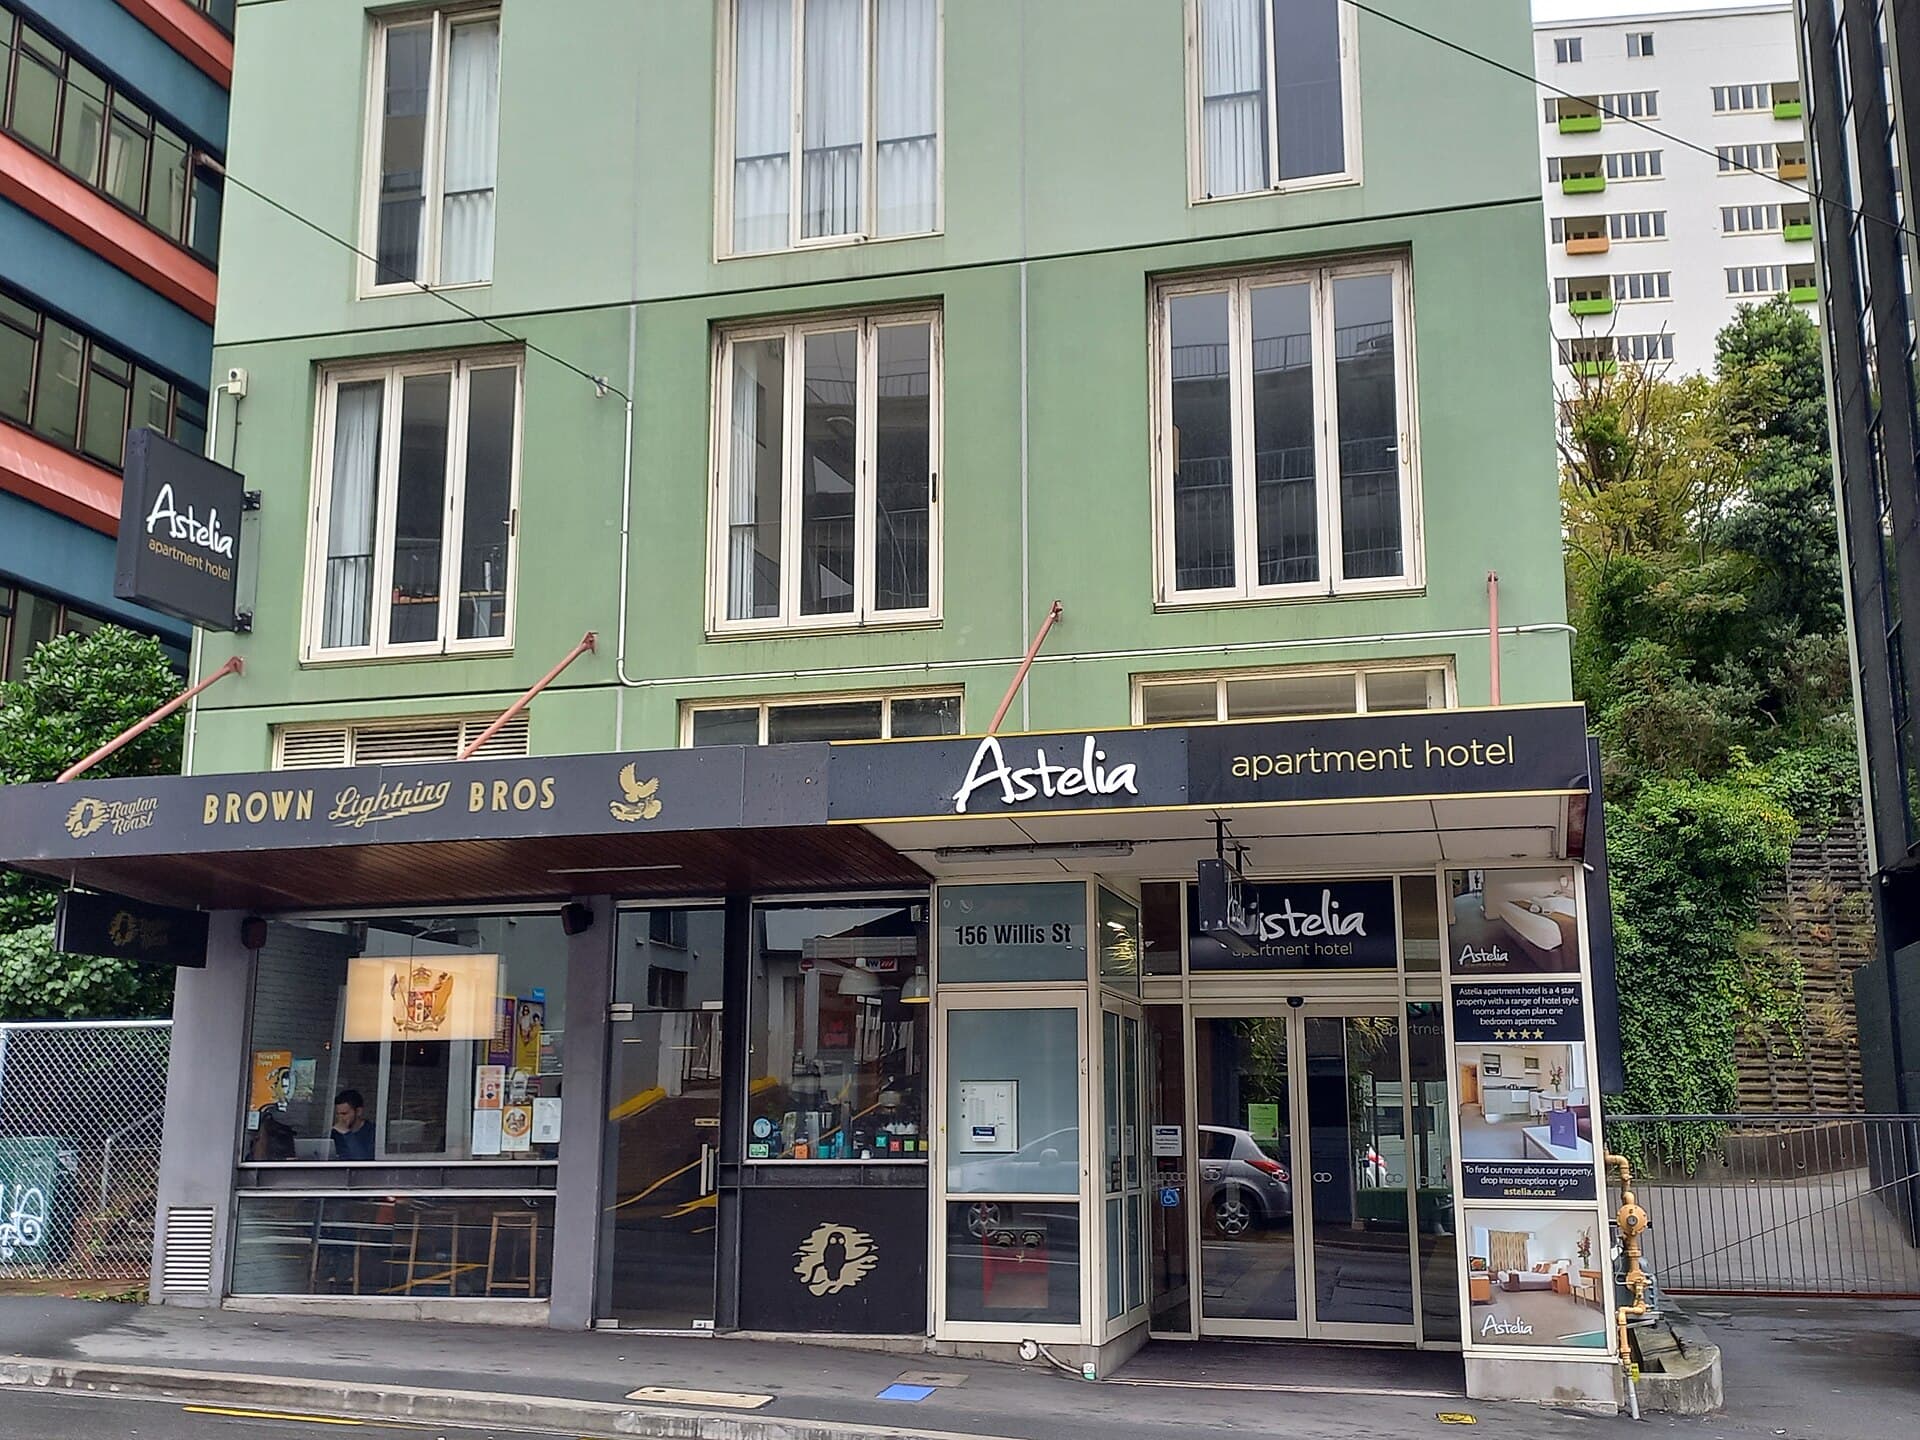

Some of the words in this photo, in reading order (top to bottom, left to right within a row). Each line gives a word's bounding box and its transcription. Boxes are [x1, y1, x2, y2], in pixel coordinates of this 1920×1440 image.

[146, 483, 233, 559] Astelia
[148, 539, 203, 570] apartment
[205, 559, 231, 580] hotel
[953, 736, 1138, 813] Astelia
[1231, 747, 1413, 781] apartment
[1425, 735, 1515, 768] hotel
[109, 797, 158, 820] Raglan
[203, 790, 313, 824] BROWN
[328, 781, 451, 828] Lightning
[468, 777, 555, 812] BROS
[111, 811, 153, 835] Roast
[1259, 889, 1366, 941] stelia
[955, 925, 988, 945] 156
[993, 924, 1045, 944] Willis
[1051, 923, 1071, 943] St
[1314, 941, 1352, 956] hotel
[1458, 944, 1508, 965] Astelia
[1456, 998, 1487, 1007] property
[1488, 997, 1504, 1005] with
[1511, 998, 1532, 1006] range
[1533, 997, 1541, 1005] of
[1542, 997, 1561, 1005] hotel
[1562, 997, 1579, 1006] style
[1483, 988, 1521, 997] apartment
[1522, 987, 1541, 995] hotel
[1511, 1009, 1531, 1017] open
[1532, 1007, 1548, 1017] plan
[1514, 1018, 1557, 1026] apartments.
[1465, 1166, 1474, 1174] To
[1475, 1166, 1489, 1174] find
[1490, 1166, 1503, 1174] out
[1524, 1167, 1545, 1175] about
[1560, 1168, 1593, 1176] property,
[1480, 1177, 1498, 1186] drop
[1514, 1177, 1548, 1186] reception
[1558, 1179, 1569, 1187] go
[1503, 1188, 1556, 1196] astelia.co.nz
[1480, 1314, 1533, 1337] Astelia
